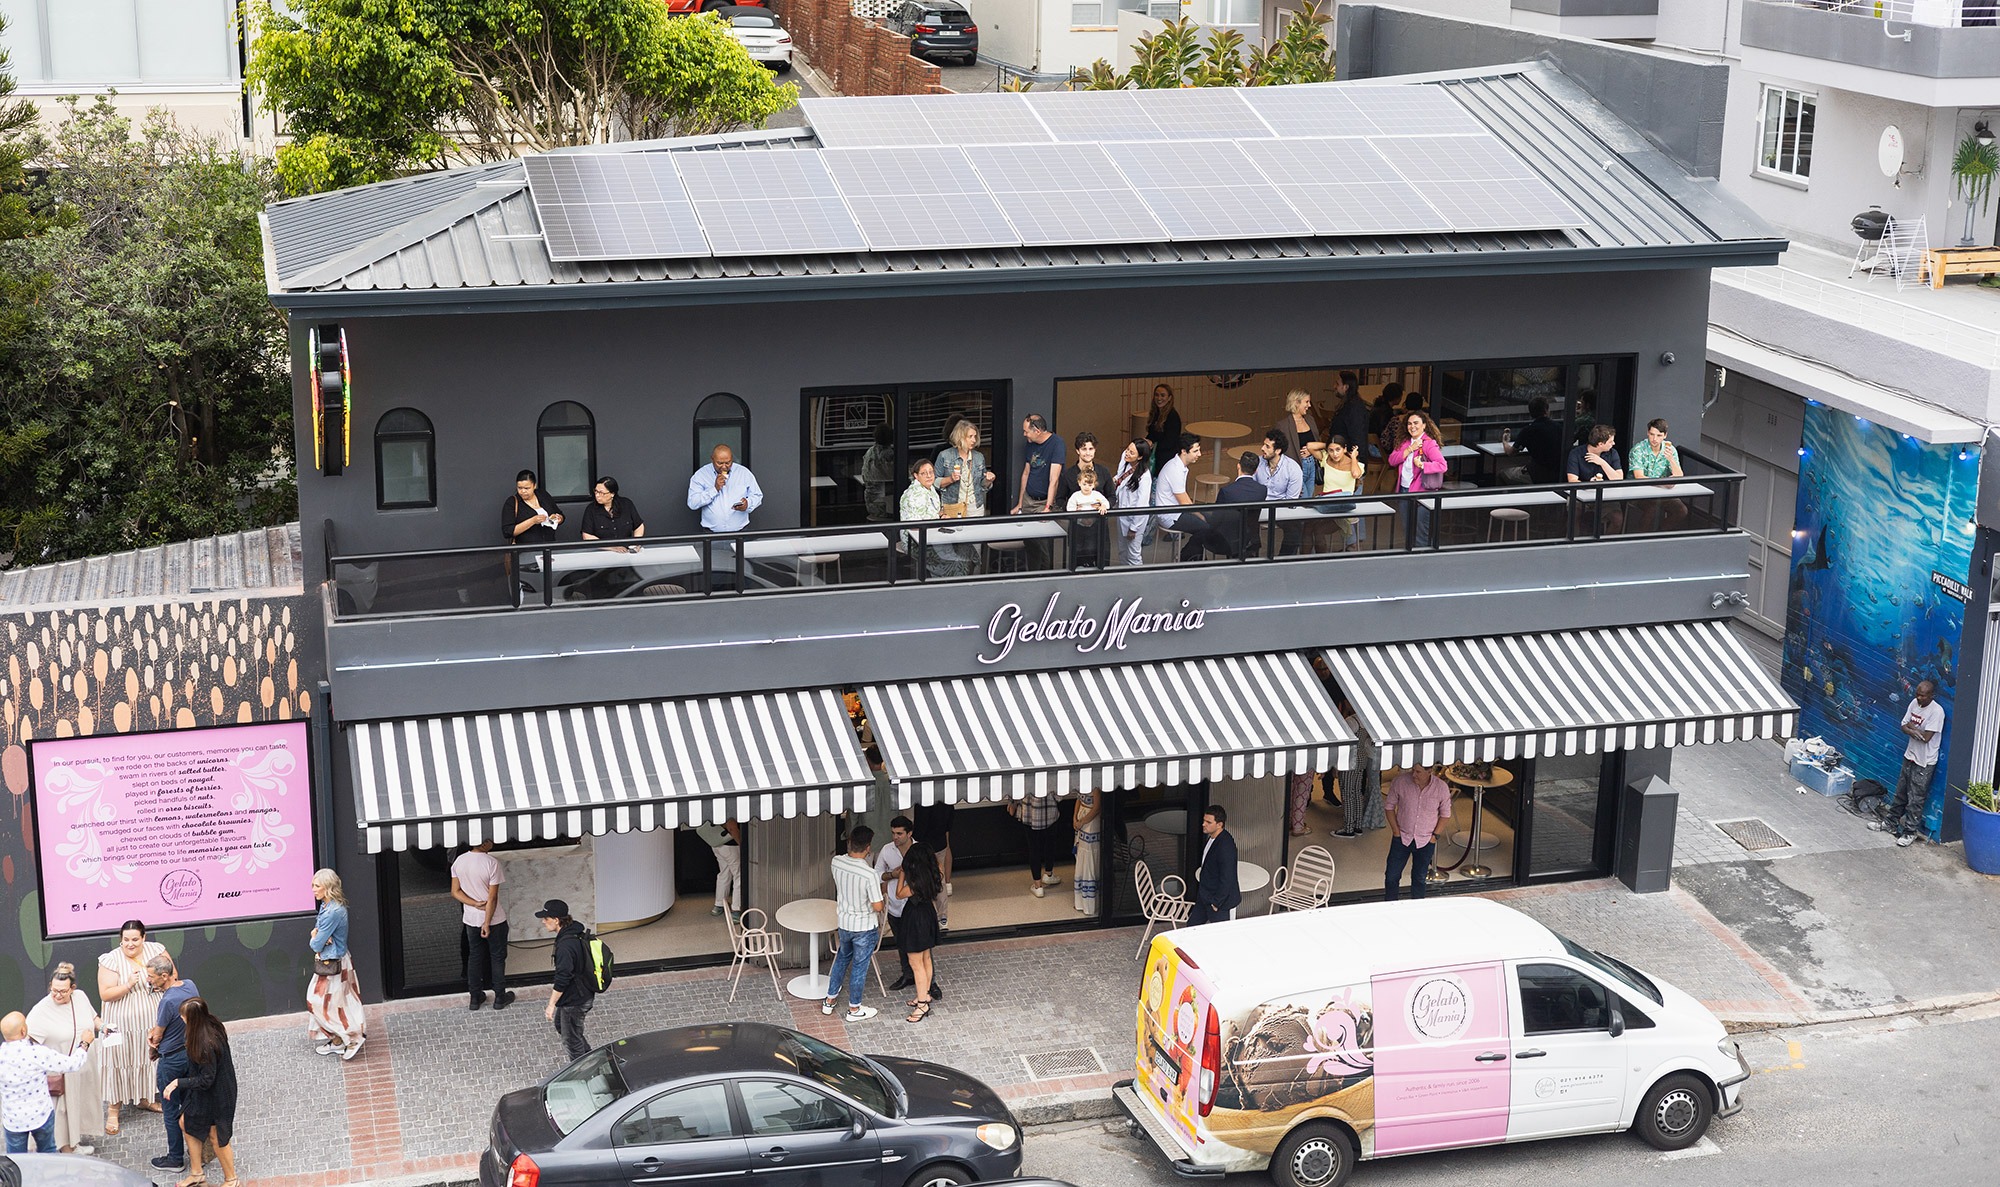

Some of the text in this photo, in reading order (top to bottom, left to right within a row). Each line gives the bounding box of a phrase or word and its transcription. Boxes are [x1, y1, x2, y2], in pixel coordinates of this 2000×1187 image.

[977, 592, 1205, 664] Gelato Mania
[75, 757, 101, 766] pursuit,
[137, 754, 152, 762] you,
[206, 747, 239, 755] memories
[241, 746, 254, 754] you
[167, 759, 187, 767] backs
[179, 767, 201, 775] salted
[132, 780, 149, 788] slept
[161, 778, 178, 786] beds
[125, 789, 148, 798] played
[156, 787, 184, 797] forests
[185, 785, 194, 794] of
[195, 784, 223, 792] berries.
[134, 798, 157, 806] picked
[158, 795, 188, 804] handfuls
[197, 793, 216, 801] nuts.
[137, 807, 156, 815] rolled
[70, 821, 105, 830] quenched
[154, 815, 184, 823] lemons,
[185, 810, 233, 820] watermelons
[99, 828, 131, 836] smudged
[181, 820, 217, 829] chocolate
[120, 835, 147, 843] chewed
[159, 832, 182, 840] clouds
[191, 829, 217, 837] bubble
[218, 828, 236, 837] gum.
[103, 854, 125, 862] brings
[139, 851, 167, 859] promise
[188, 846, 223, 854] memories
[224, 845, 238, 853] you
[253, 841, 272, 849] taste
[115, 845, 129, 853] just
[174, 837, 219, 847] unforgettable
[128, 859, 159, 867] welcome
[163, 874, 197, 895] Gelato
[166, 888, 198, 900] Mania
[217, 890, 242, 899] new
[1416, 986, 1459, 1019] Gelato
[1420, 1008, 1461, 1028] Mania
